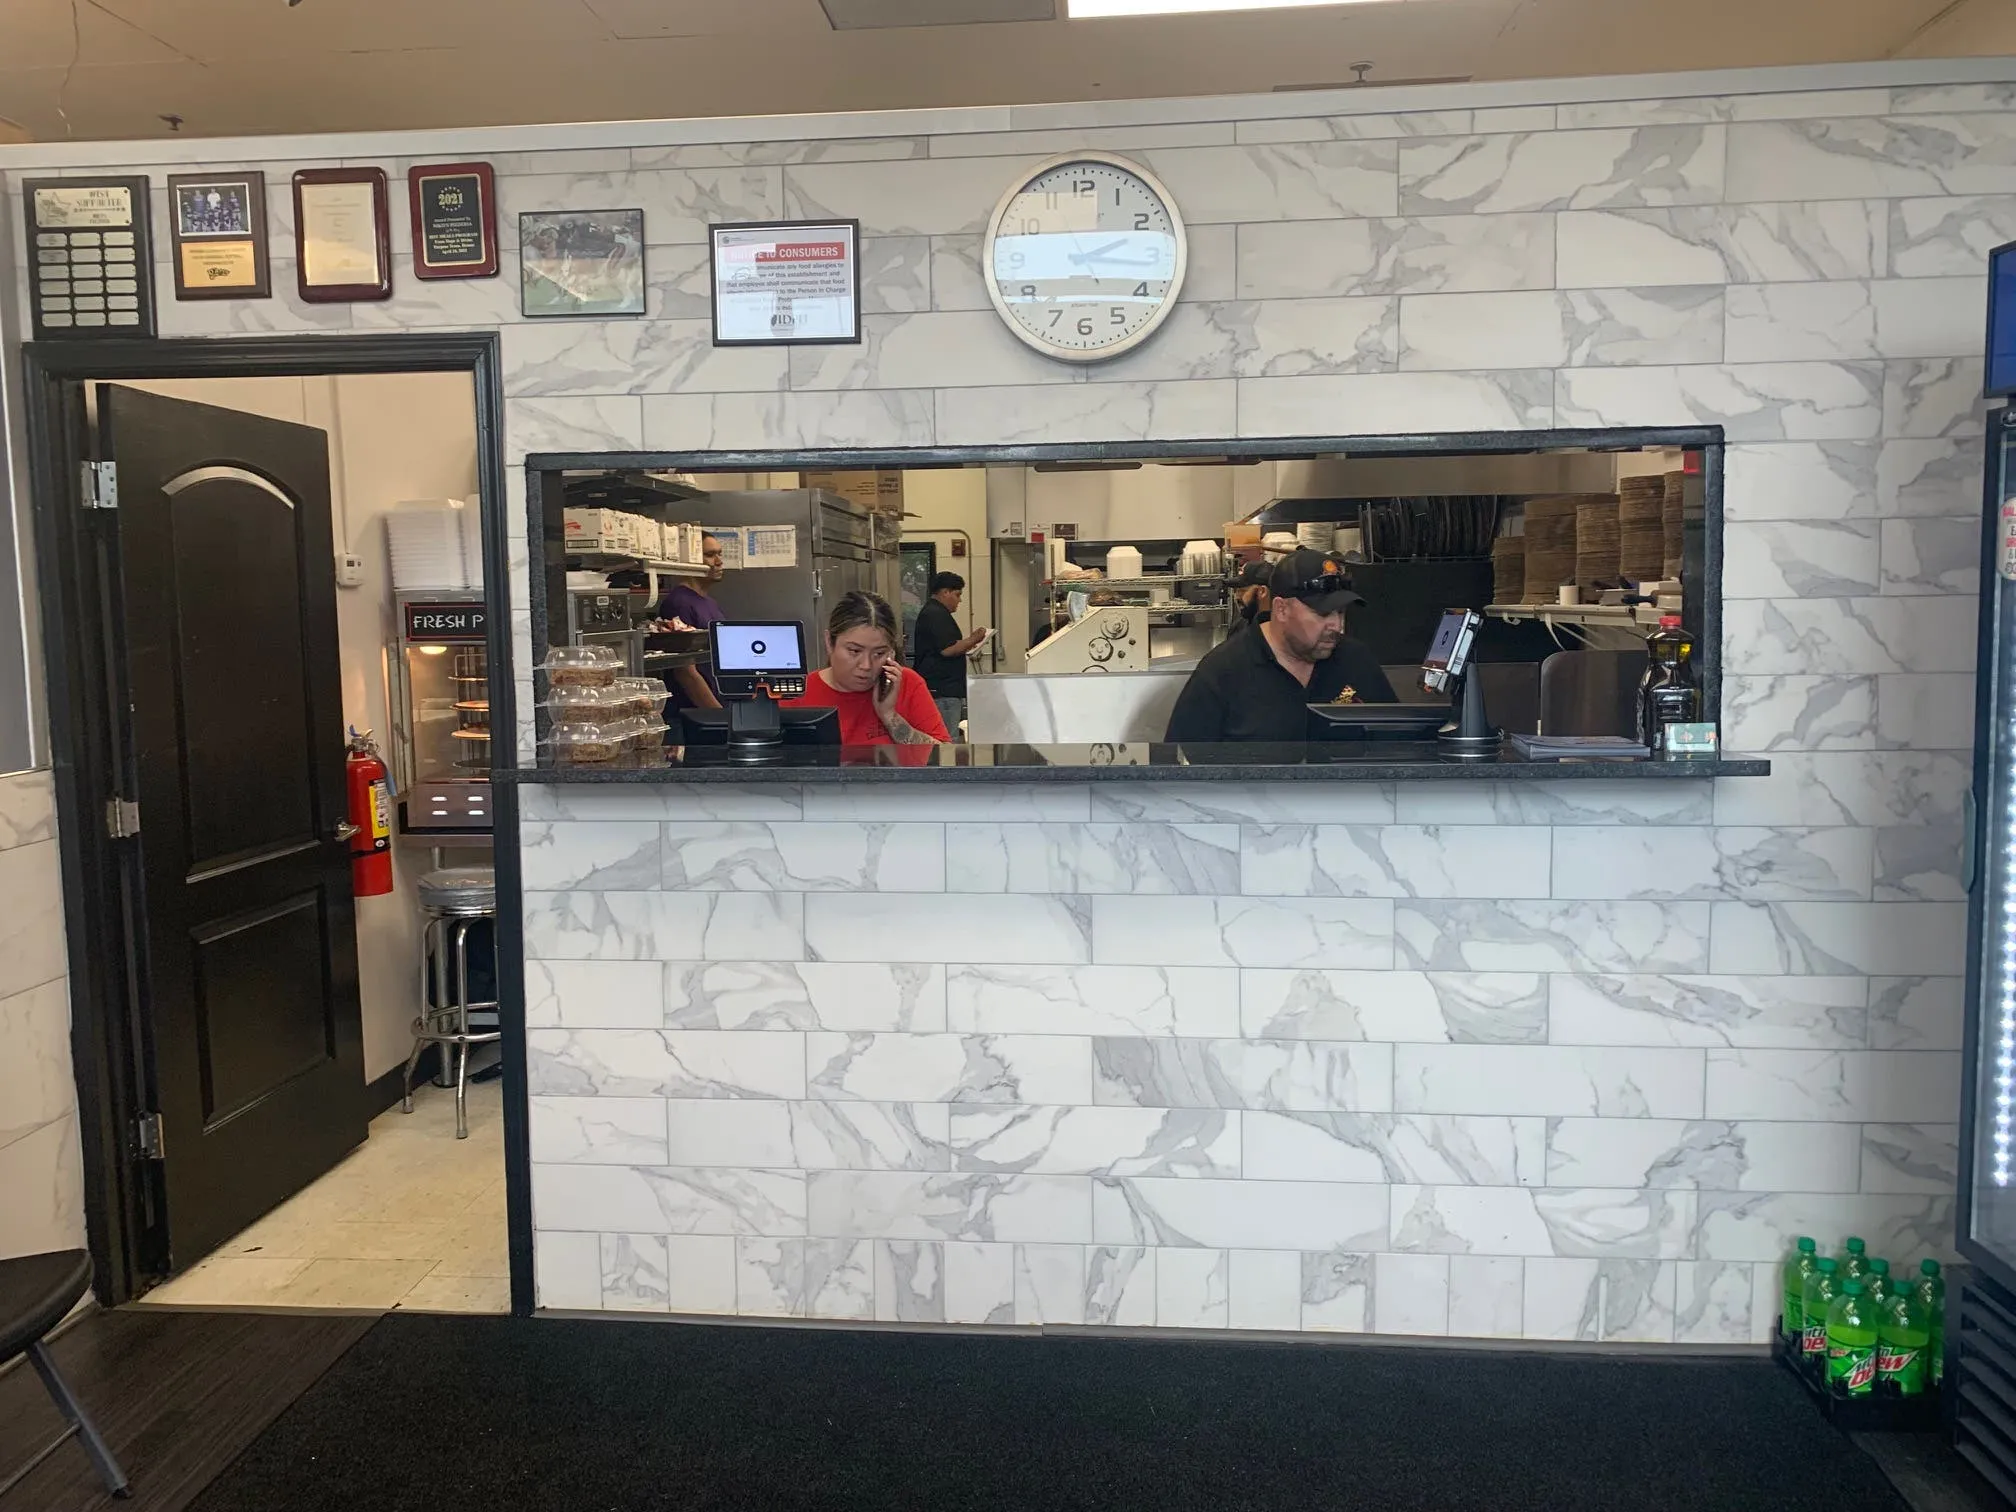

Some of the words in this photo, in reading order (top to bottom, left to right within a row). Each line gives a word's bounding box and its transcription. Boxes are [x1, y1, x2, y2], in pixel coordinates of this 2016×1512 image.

[1073, 180, 1095, 198] 12
[1115, 188, 1120, 206] 1
[438, 193, 463, 206] 2021
[1046, 191, 1058, 210] 11
[1020, 218, 1040, 236] 10
[1134, 213, 1149, 231] 2
[779, 247, 838, 258] CONSUMERS
[1010, 252, 1025, 270] 9
[1143, 247, 1160, 264] 3
[1021, 284, 1037, 303] 8
[1132, 282, 1149, 297] 4
[1048, 309, 1064, 327] 7
[1110, 307, 1126, 325] 5
[1077, 318, 1093, 335] 6
[413, 615, 465, 628] FRESH
